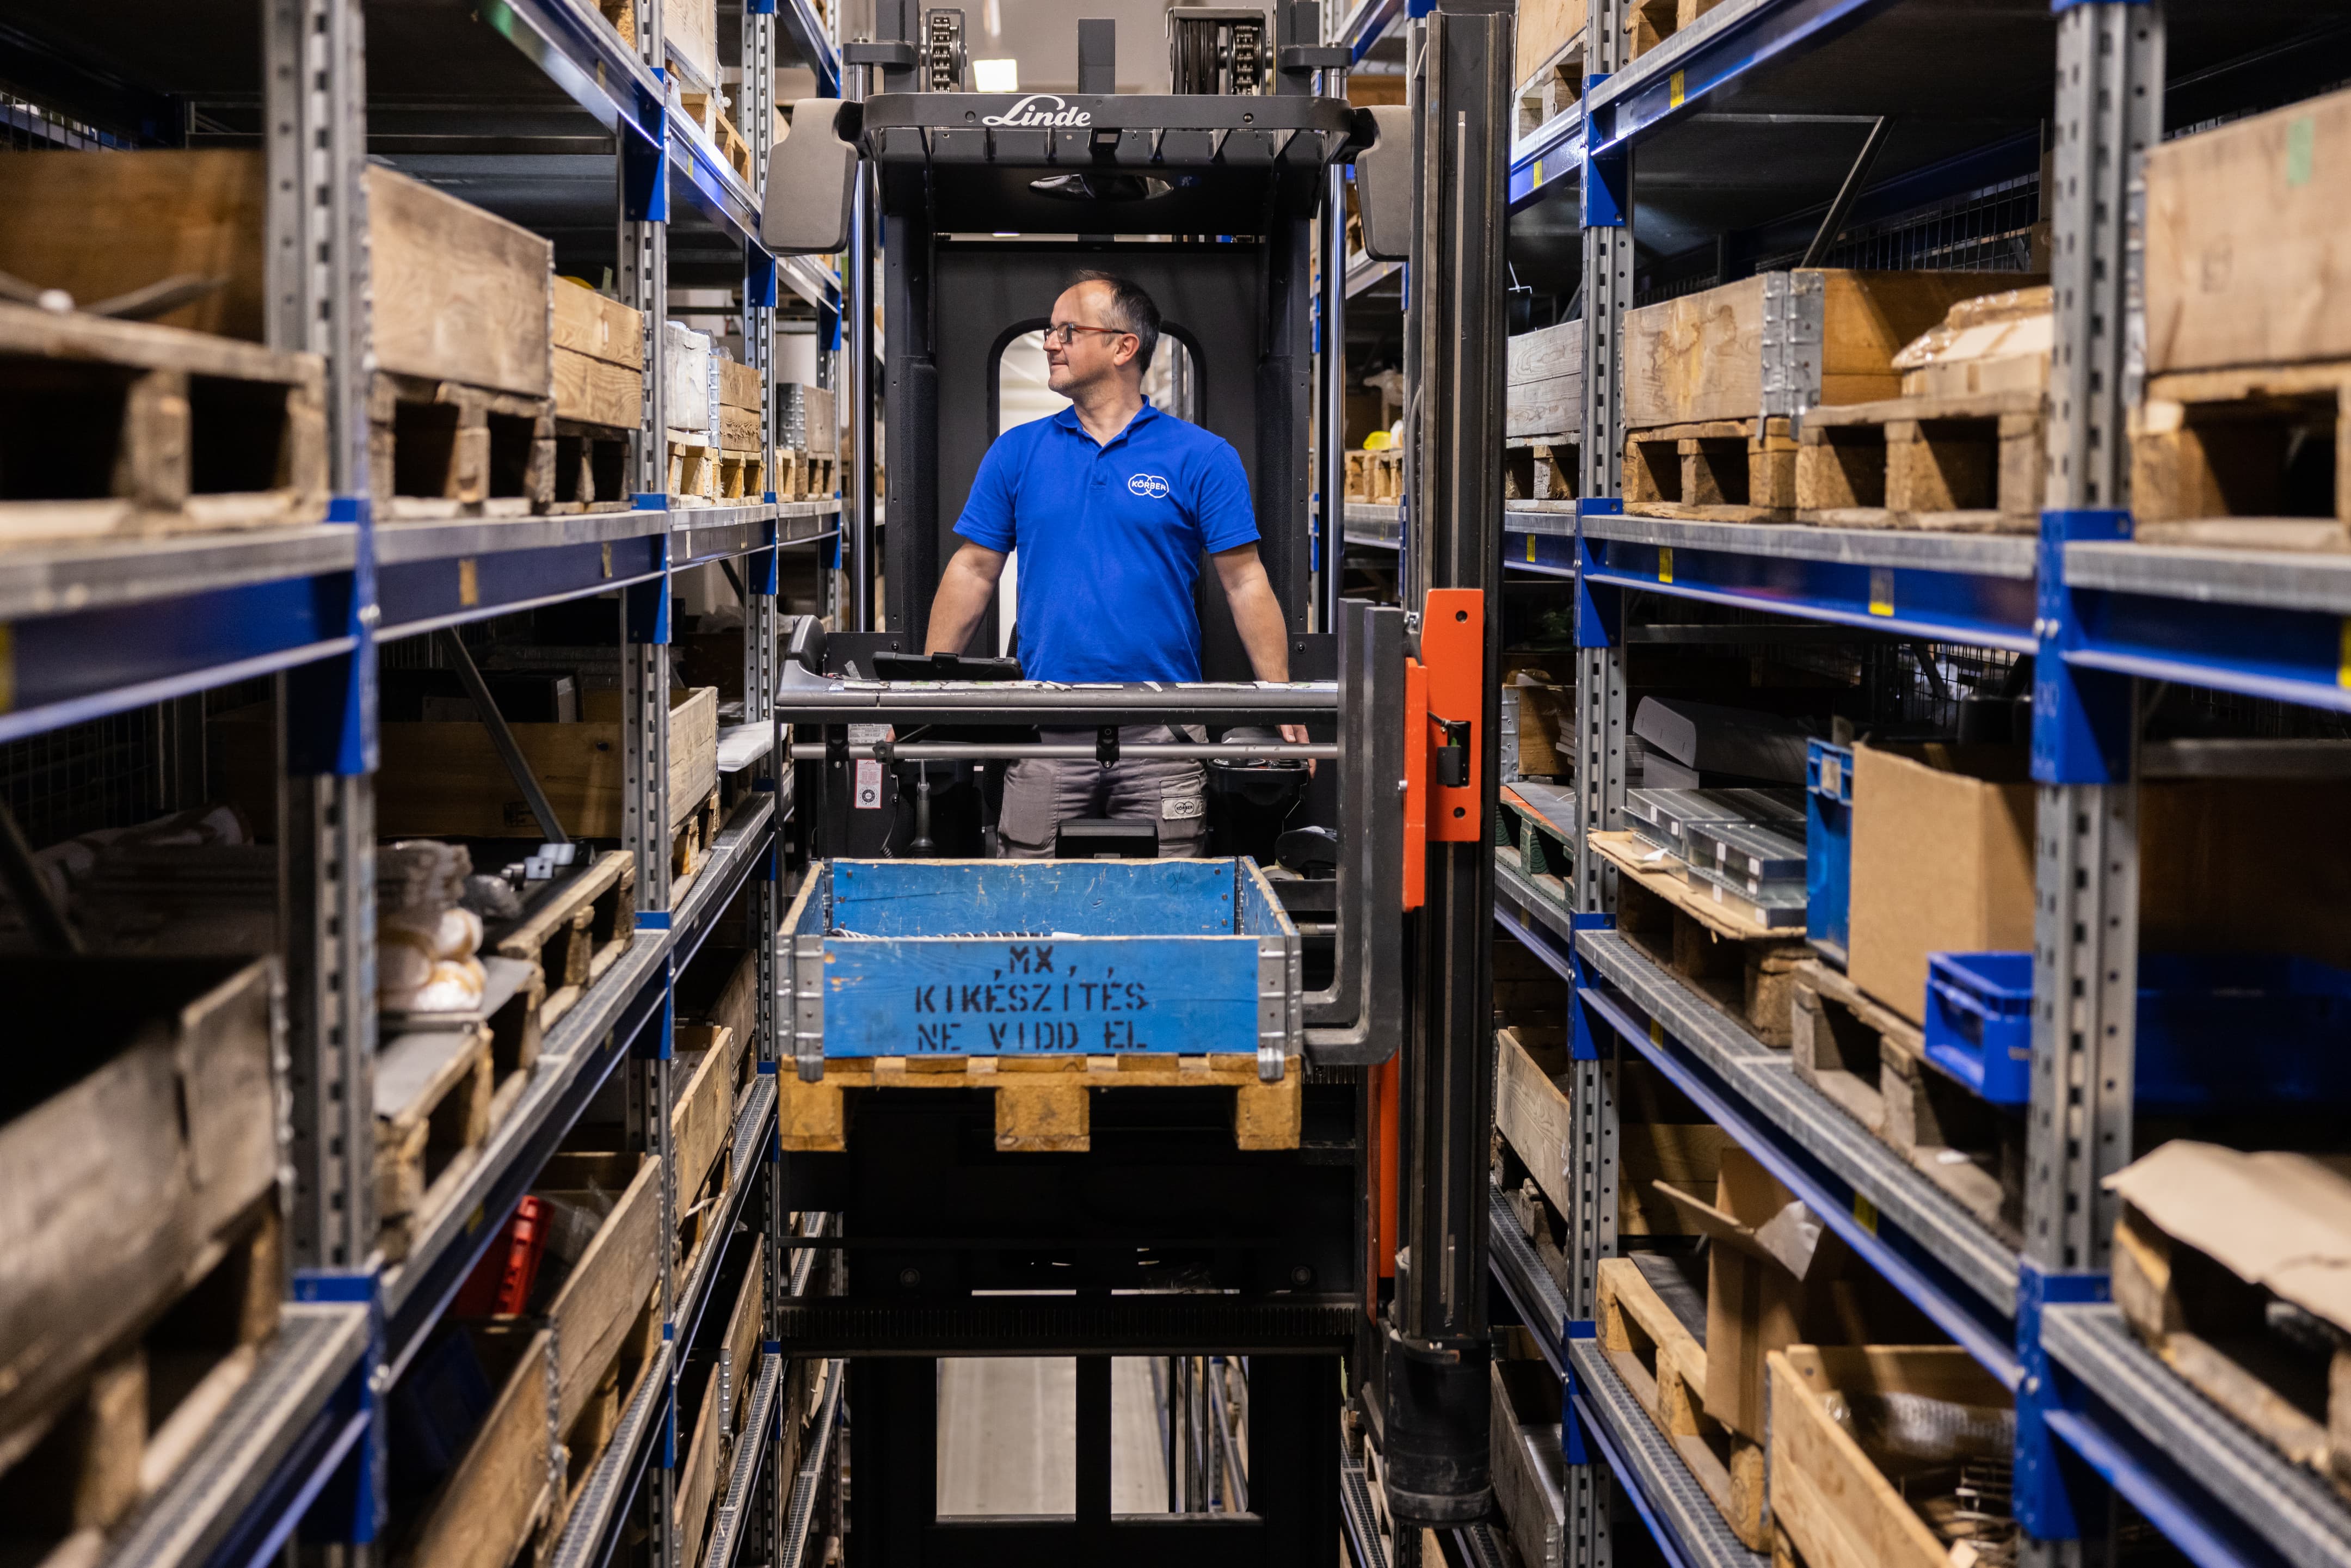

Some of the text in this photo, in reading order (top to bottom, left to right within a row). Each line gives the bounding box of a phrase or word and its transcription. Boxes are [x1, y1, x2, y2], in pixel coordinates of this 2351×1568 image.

[982, 94, 1091, 126] Linde
[1132, 479, 1166, 491] KÖRBER
[1010, 945, 1054, 974] MX
[918, 1021, 1147, 1051] NE VIDD EL
